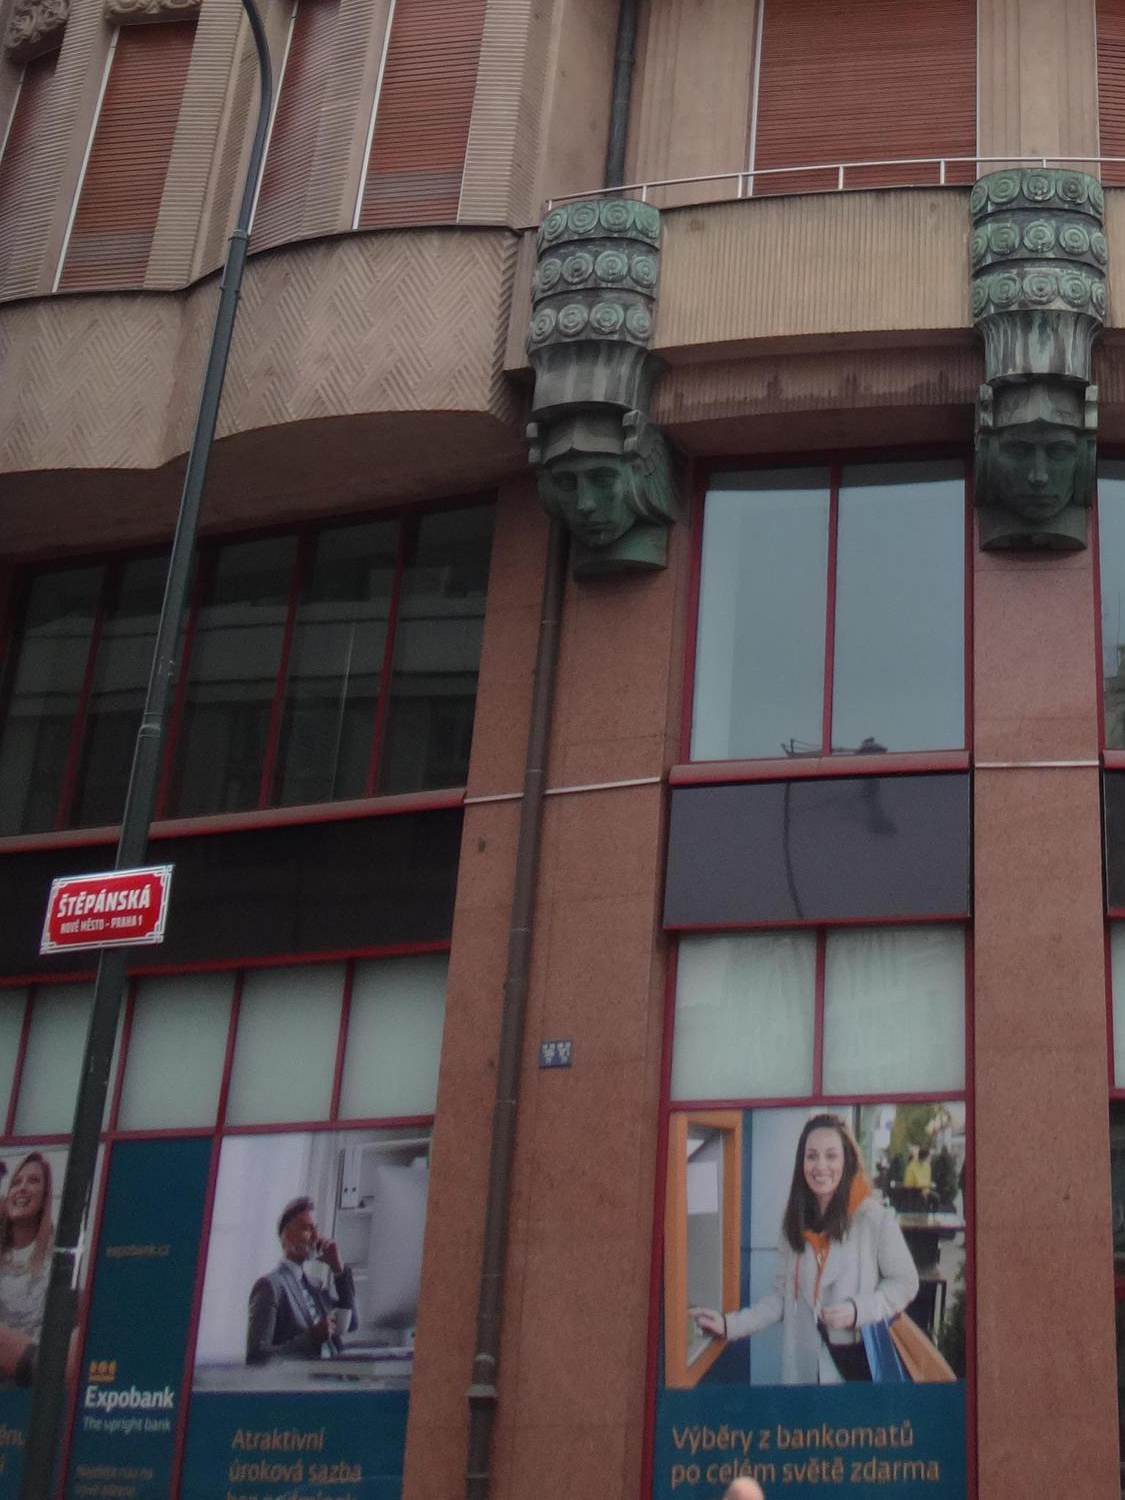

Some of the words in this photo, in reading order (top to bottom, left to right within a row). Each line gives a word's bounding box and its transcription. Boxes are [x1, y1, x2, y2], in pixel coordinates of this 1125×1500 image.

[57, 884, 151, 918] ŠTĚPÁNSKÁ
[60, 919, 79, 934] NOVÉ
[80, 917, 105, 932] MĚSTO
[110, 915, 136, 929] PRAHA
[137, 914, 143, 926] 1
[84, 1385, 175, 1412] Expobank
[84, 1417, 101, 1431] The
[104, 1417, 143, 1434] upright
[144, 1417, 171, 1431] bank
[231, 1426, 326, 1451] Atraktivní
[672, 1423, 753, 1456] Výběry
[759, 1429, 771, 1450] z
[776, 1419, 914, 1450] bankomatů
[229, 1458, 304, 1483] úroková
[308, 1460, 363, 1484] sazba
[671, 1462, 700, 1490] po
[706, 1457, 775, 1485] celém
[782, 1457, 844, 1484] světě
[850, 1456, 940, 1483] zdarma
